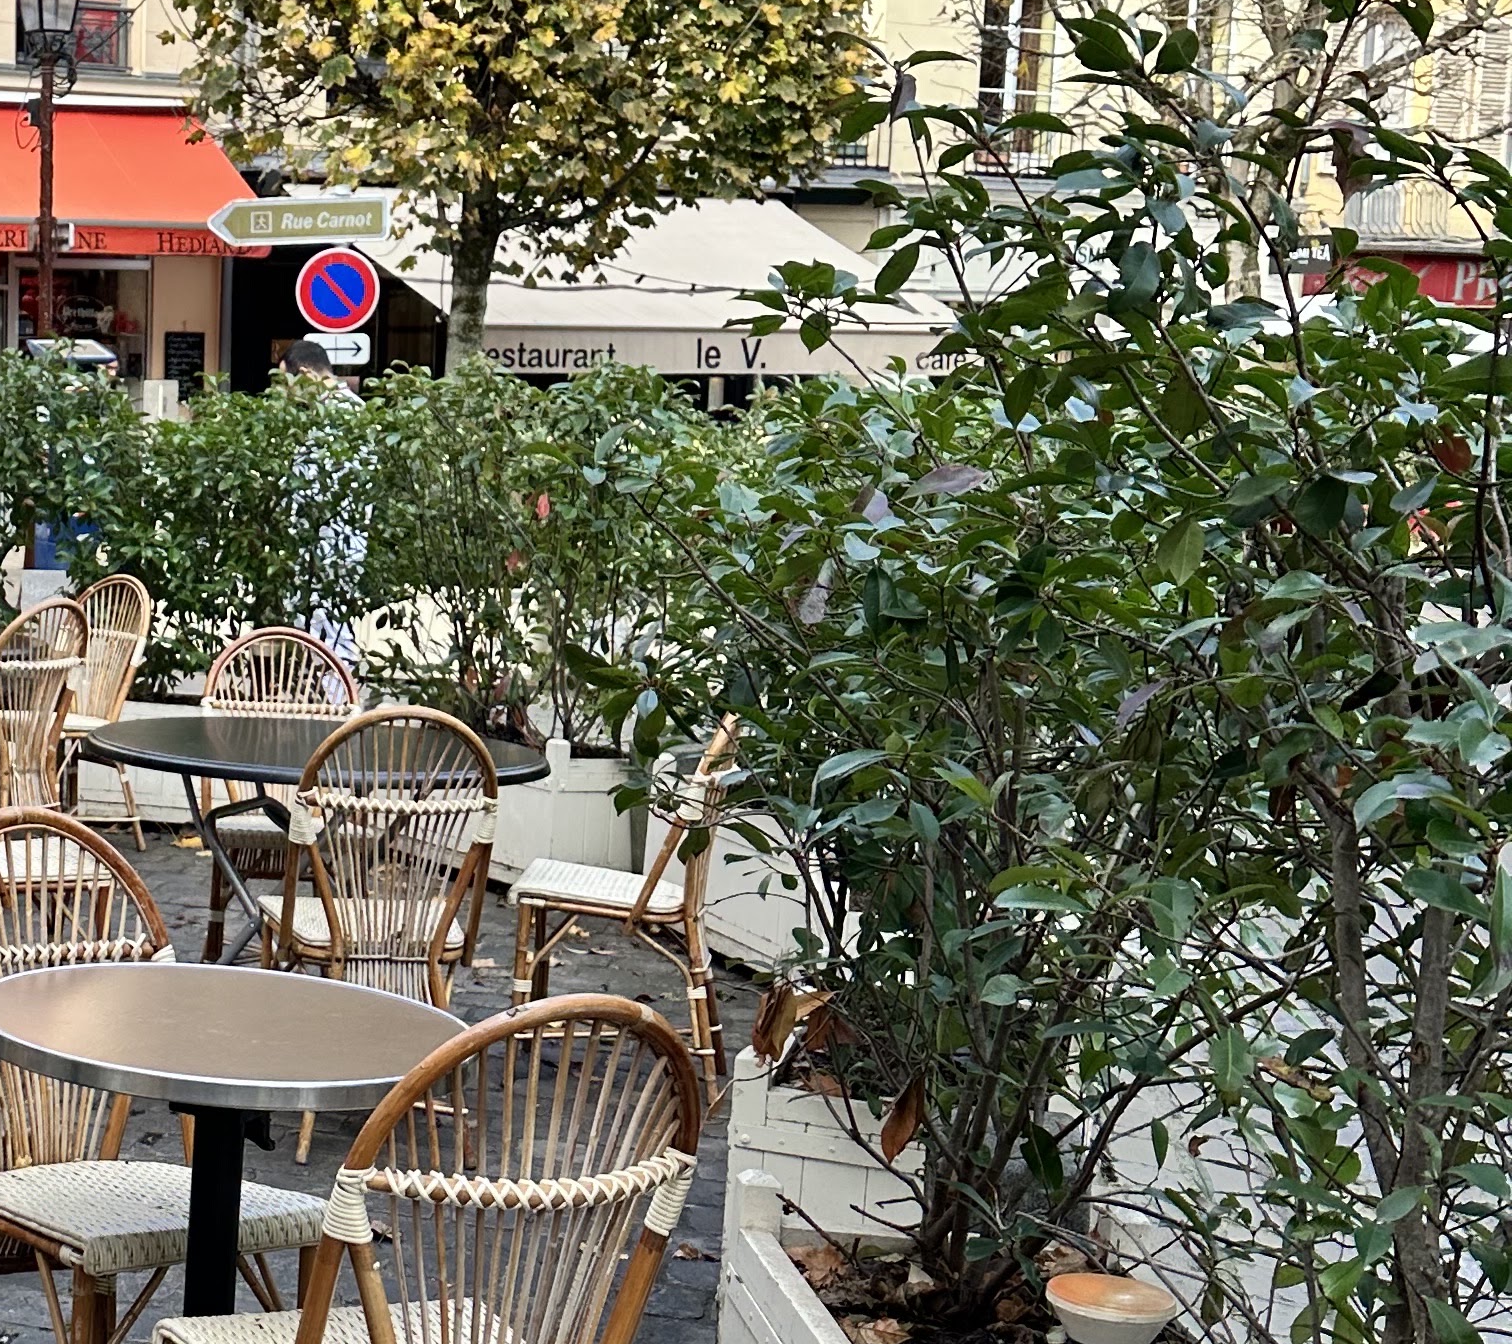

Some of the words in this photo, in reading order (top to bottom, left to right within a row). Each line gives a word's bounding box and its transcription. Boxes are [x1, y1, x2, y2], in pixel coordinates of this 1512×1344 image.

[280, 212, 313, 230] Rue
[316, 210, 374, 229] Carnot
[77, 231, 108, 250] NE
[482, 341, 616, 368] estaurant
[696, 338, 722, 369] le
[740, 337, 767, 369] V.
